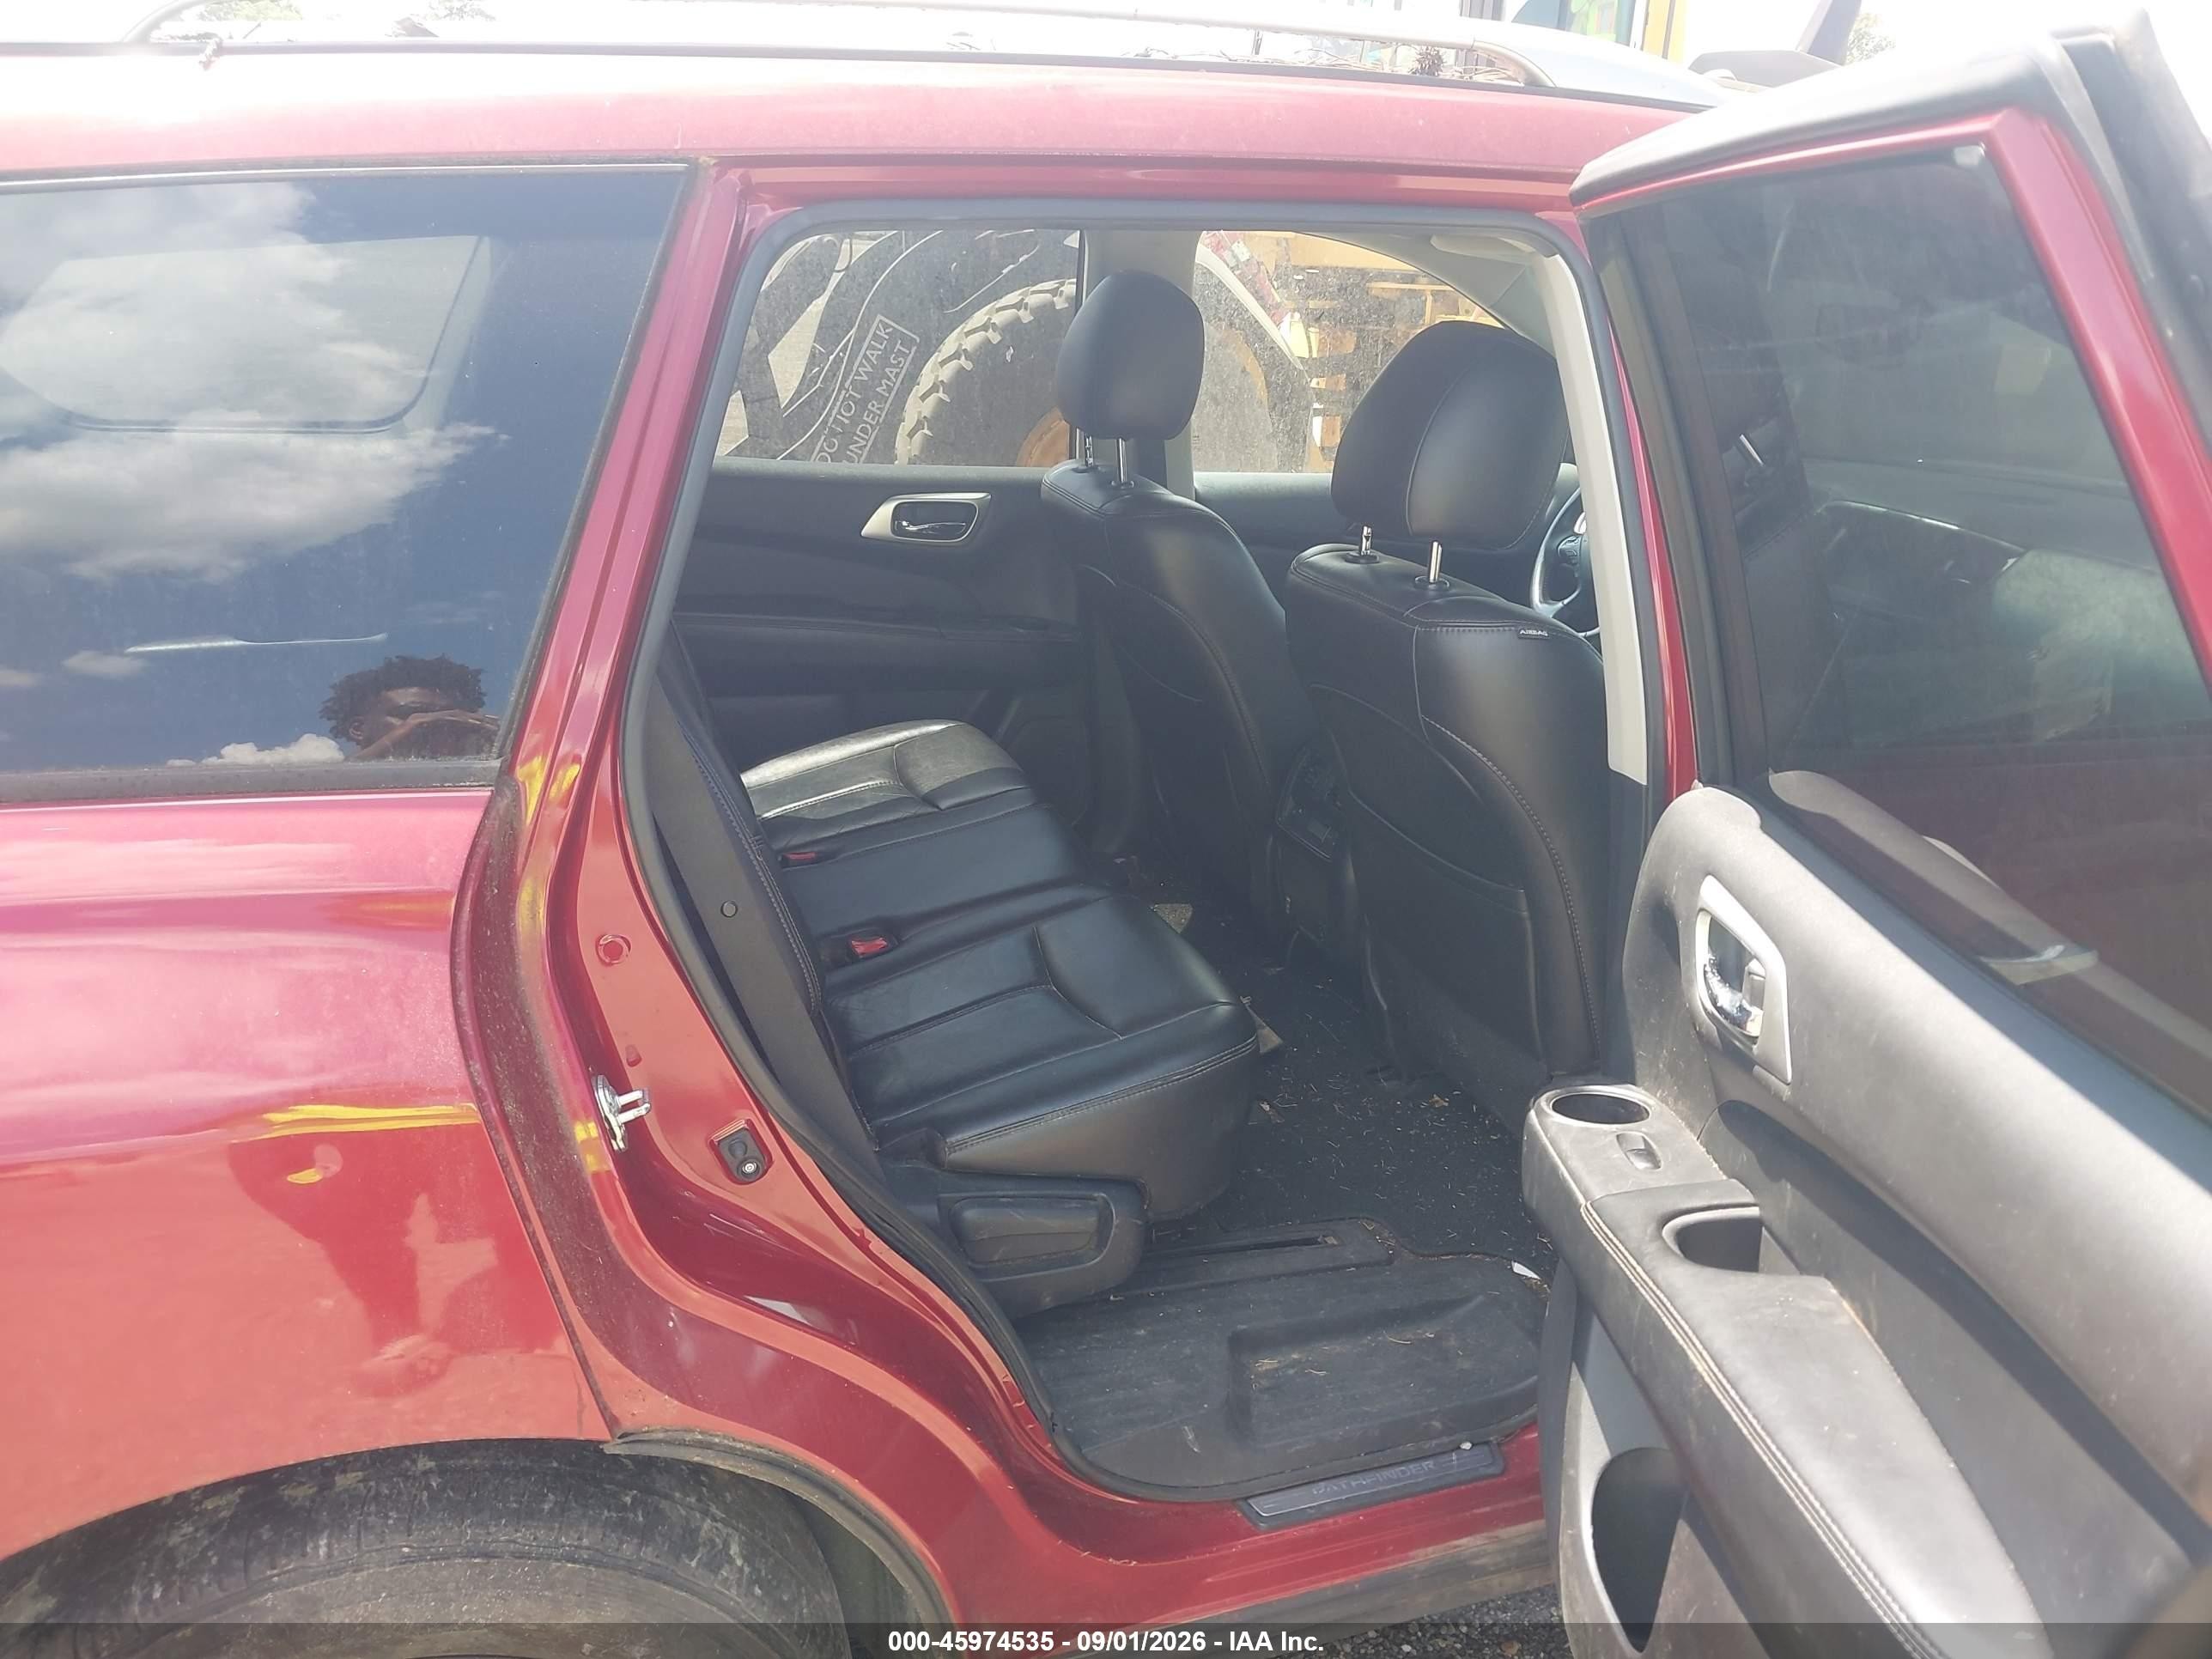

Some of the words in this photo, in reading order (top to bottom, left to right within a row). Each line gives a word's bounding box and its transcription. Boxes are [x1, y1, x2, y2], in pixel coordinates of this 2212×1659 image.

[831, 386, 861, 433] NOT
[854, 322, 893, 382] WALK
[842, 400, 884, 464] UNDER
[876, 339, 910, 398] MAST
[1312, 1460, 1437, 1495] PATHFINDER
